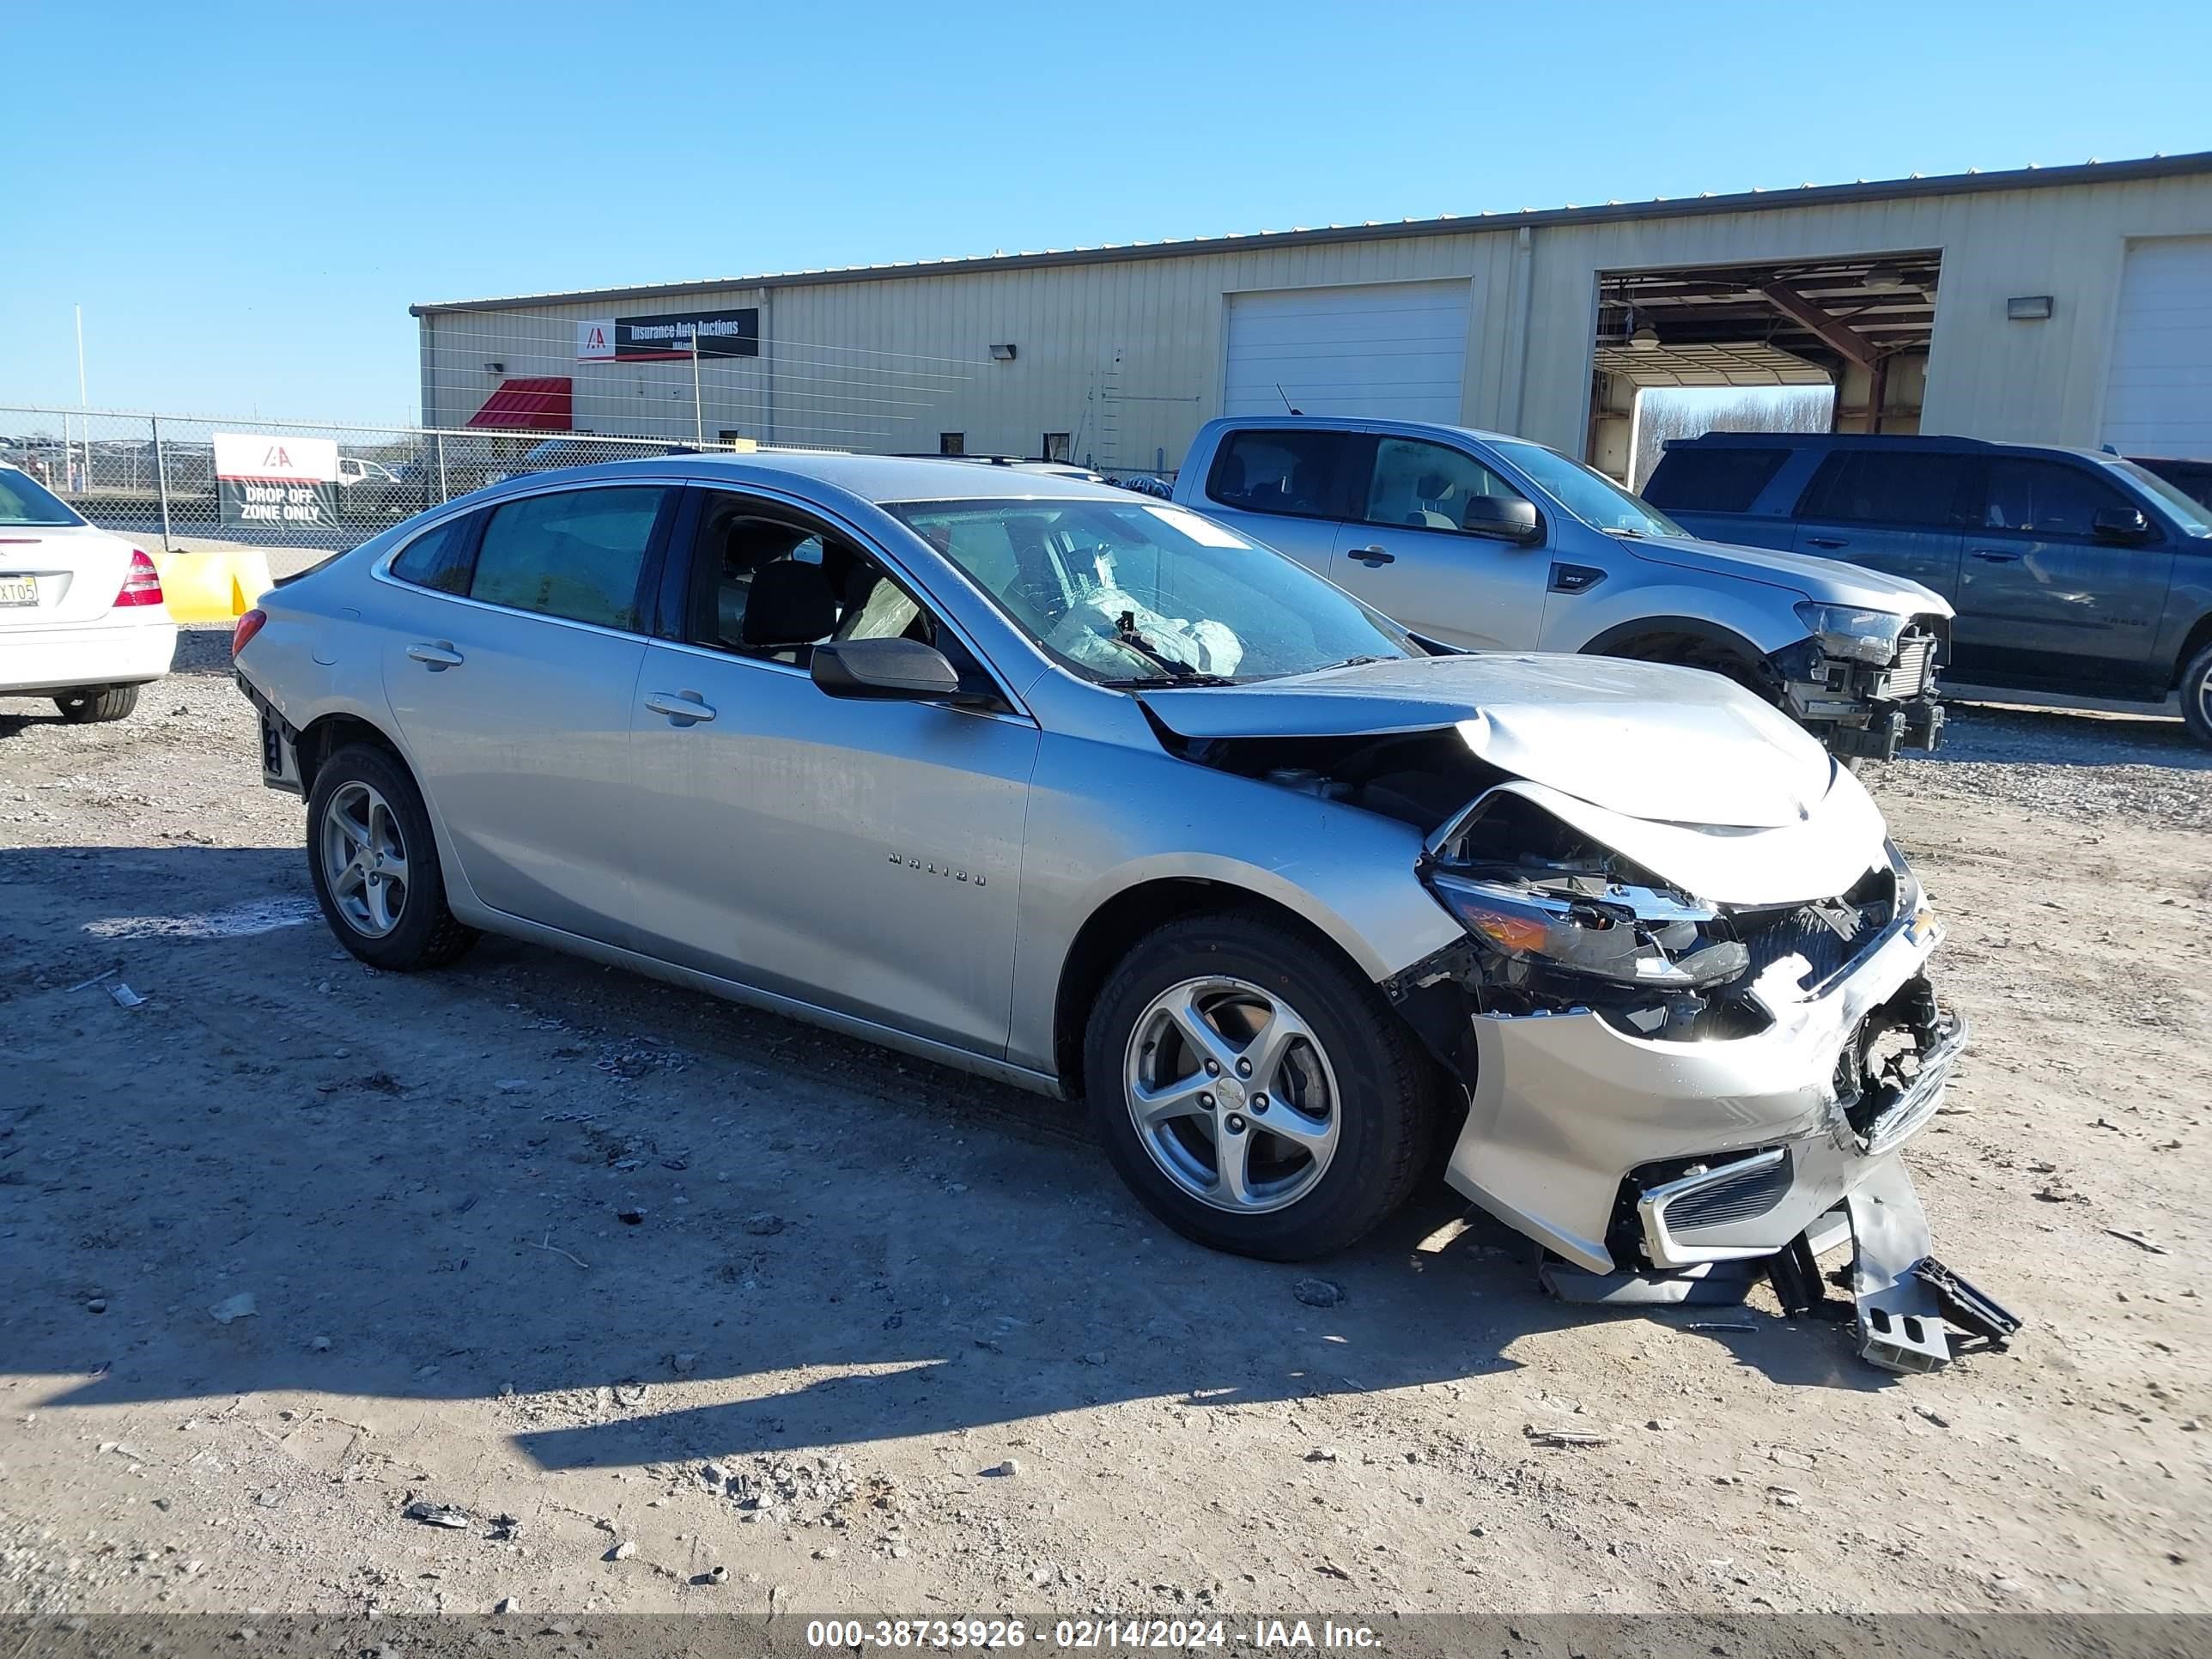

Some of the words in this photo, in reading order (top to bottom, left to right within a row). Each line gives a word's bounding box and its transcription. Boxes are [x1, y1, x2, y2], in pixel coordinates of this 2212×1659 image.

[631, 325, 675, 341] Insurance
[676, 321, 696, 337] Auto
[697, 319, 739, 337] Auctions
[245, 487, 285, 502] DROP
[289, 489, 314, 503] OFF
[240, 504, 281, 520] ZONE
[283, 505, 320, 520] ONLY
[889, 852, 987, 887] MALIBU
